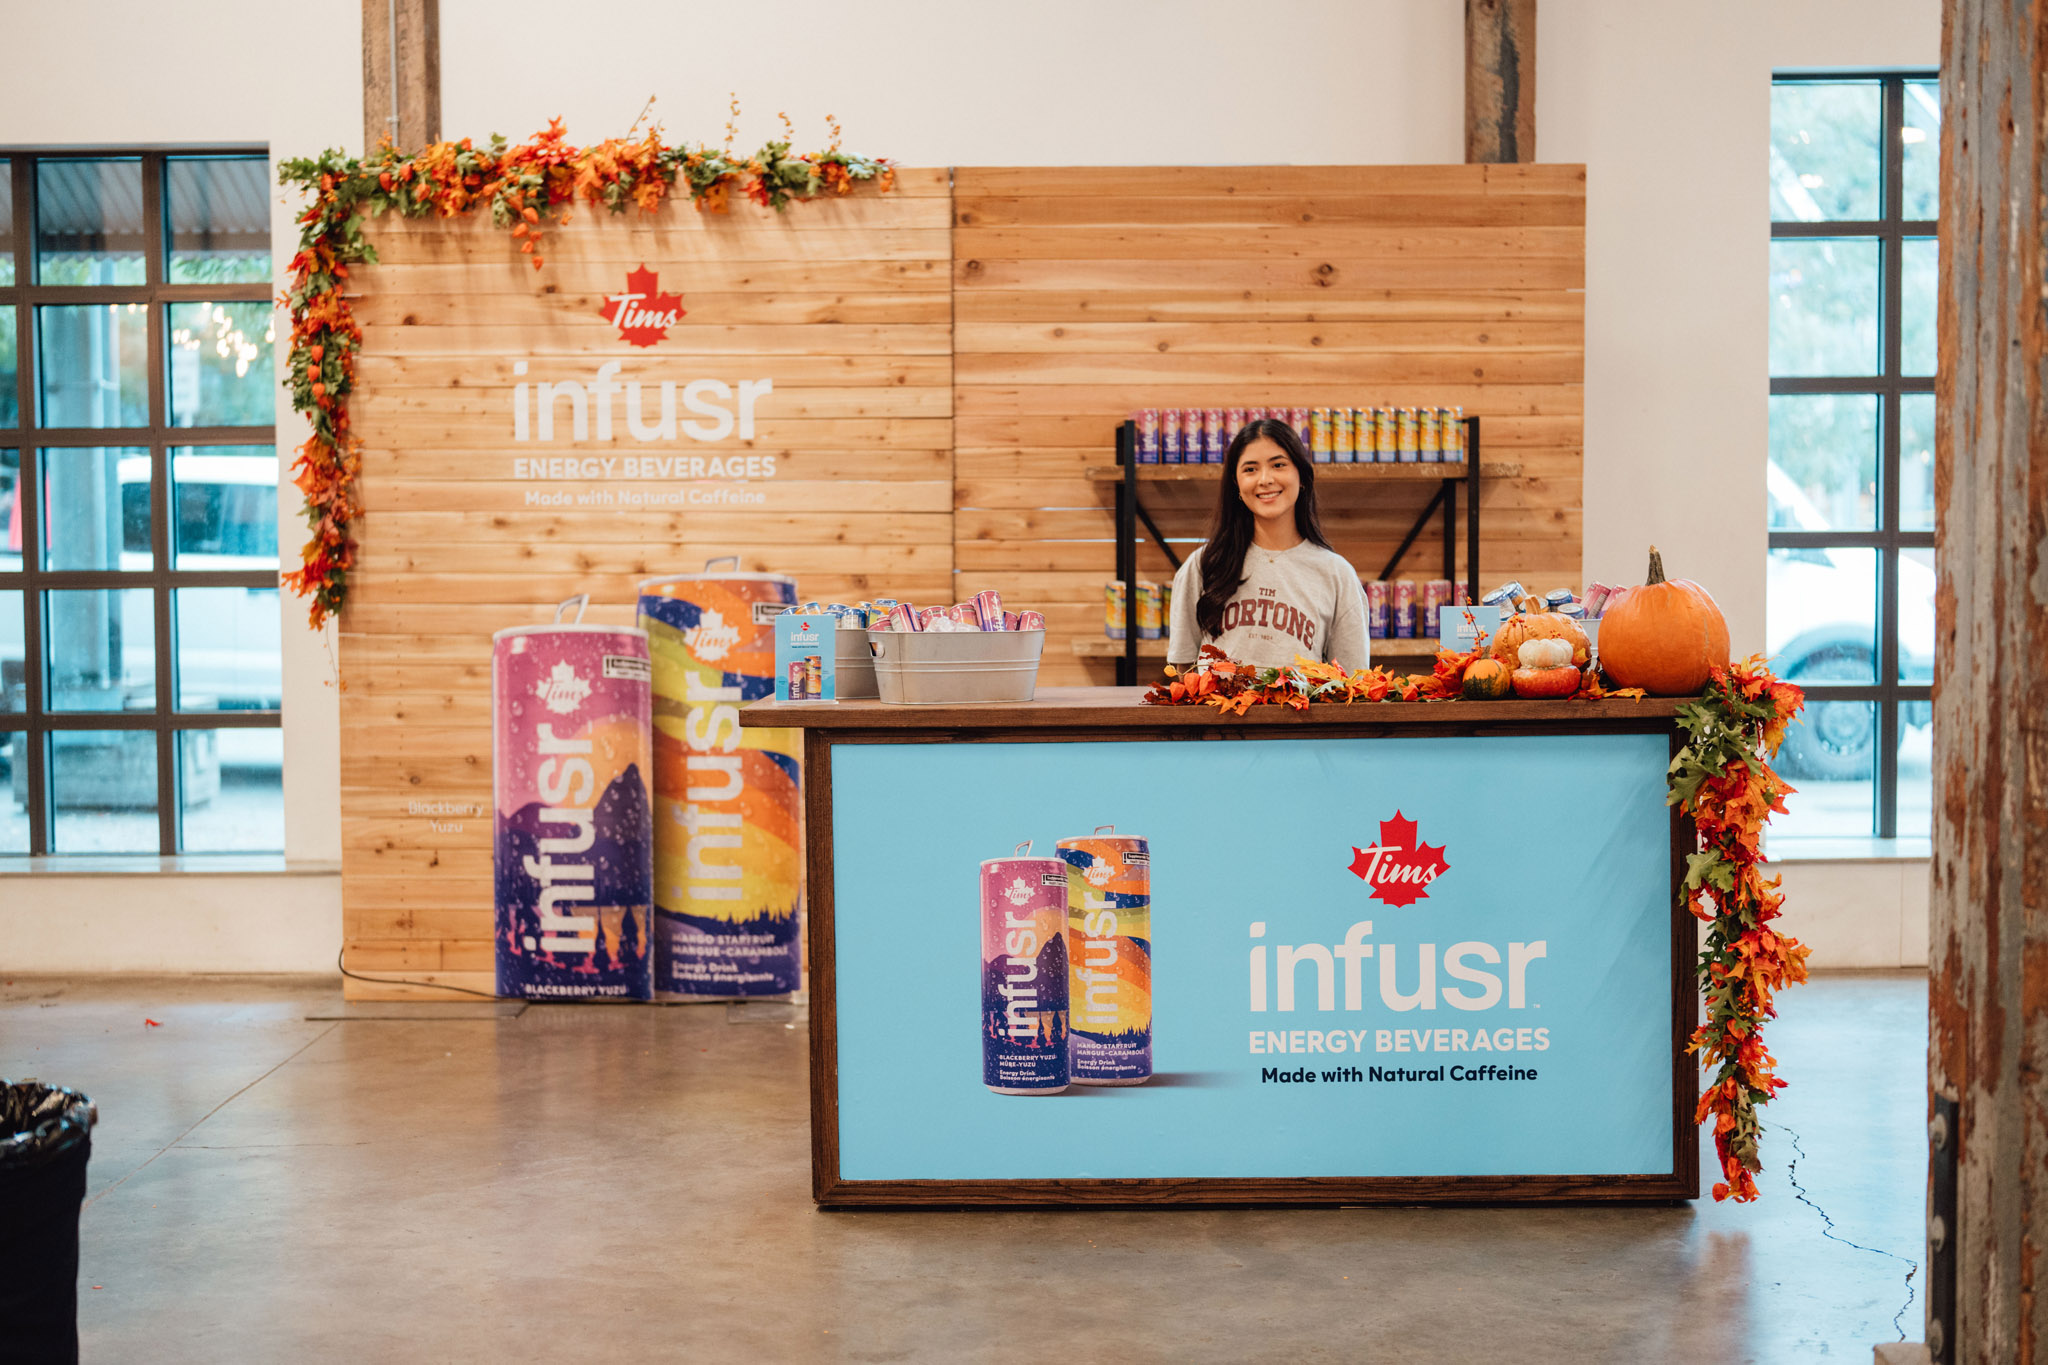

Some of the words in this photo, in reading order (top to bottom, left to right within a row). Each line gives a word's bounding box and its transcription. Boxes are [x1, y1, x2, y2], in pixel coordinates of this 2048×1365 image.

[609, 293, 678, 328] Tims
[513, 361, 773, 442] infusr
[513, 457, 616, 479] ENERGY
[624, 456, 776, 478] BEVERAGES
[525, 491, 572, 505] Made
[577, 490, 616, 505] with
[618, 490, 684, 505] Natural
[689, 488, 766, 504] Caffeine
[1259, 587, 1276, 597] TIM
[790, 632, 820, 641] infusr
[1211, 599, 1315, 651] ORTONS
[671, 671, 744, 901] infusr
[408, 800, 484, 817] Blackberry
[430, 820, 463, 832] Yuzu
[523, 723, 597, 953] infusr
[1360, 845, 1438, 885] Tims
[671, 933, 715, 945] MANGO
[717, 934, 775, 945] STARFRUIT
[672, 961, 707, 973] Energy
[709, 962, 738, 973] Drink
[1076, 891, 1118, 1024] infusr
[1249, 920, 1547, 1012] infusr
[998, 911, 1038, 1037] infusr
[525, 983, 596, 996] BLACKBERRY
[598, 984, 627, 996] YUZU
[1249, 1030, 1367, 1053] ENERGY
[1375, 1027, 1551, 1052] BEVERAGES
[1262, 1067, 1317, 1083] Made
[1321, 1066, 1363, 1083] with
[1369, 1065, 1445, 1082] Natural
[1450, 1065, 1538, 1081] Caffeine
